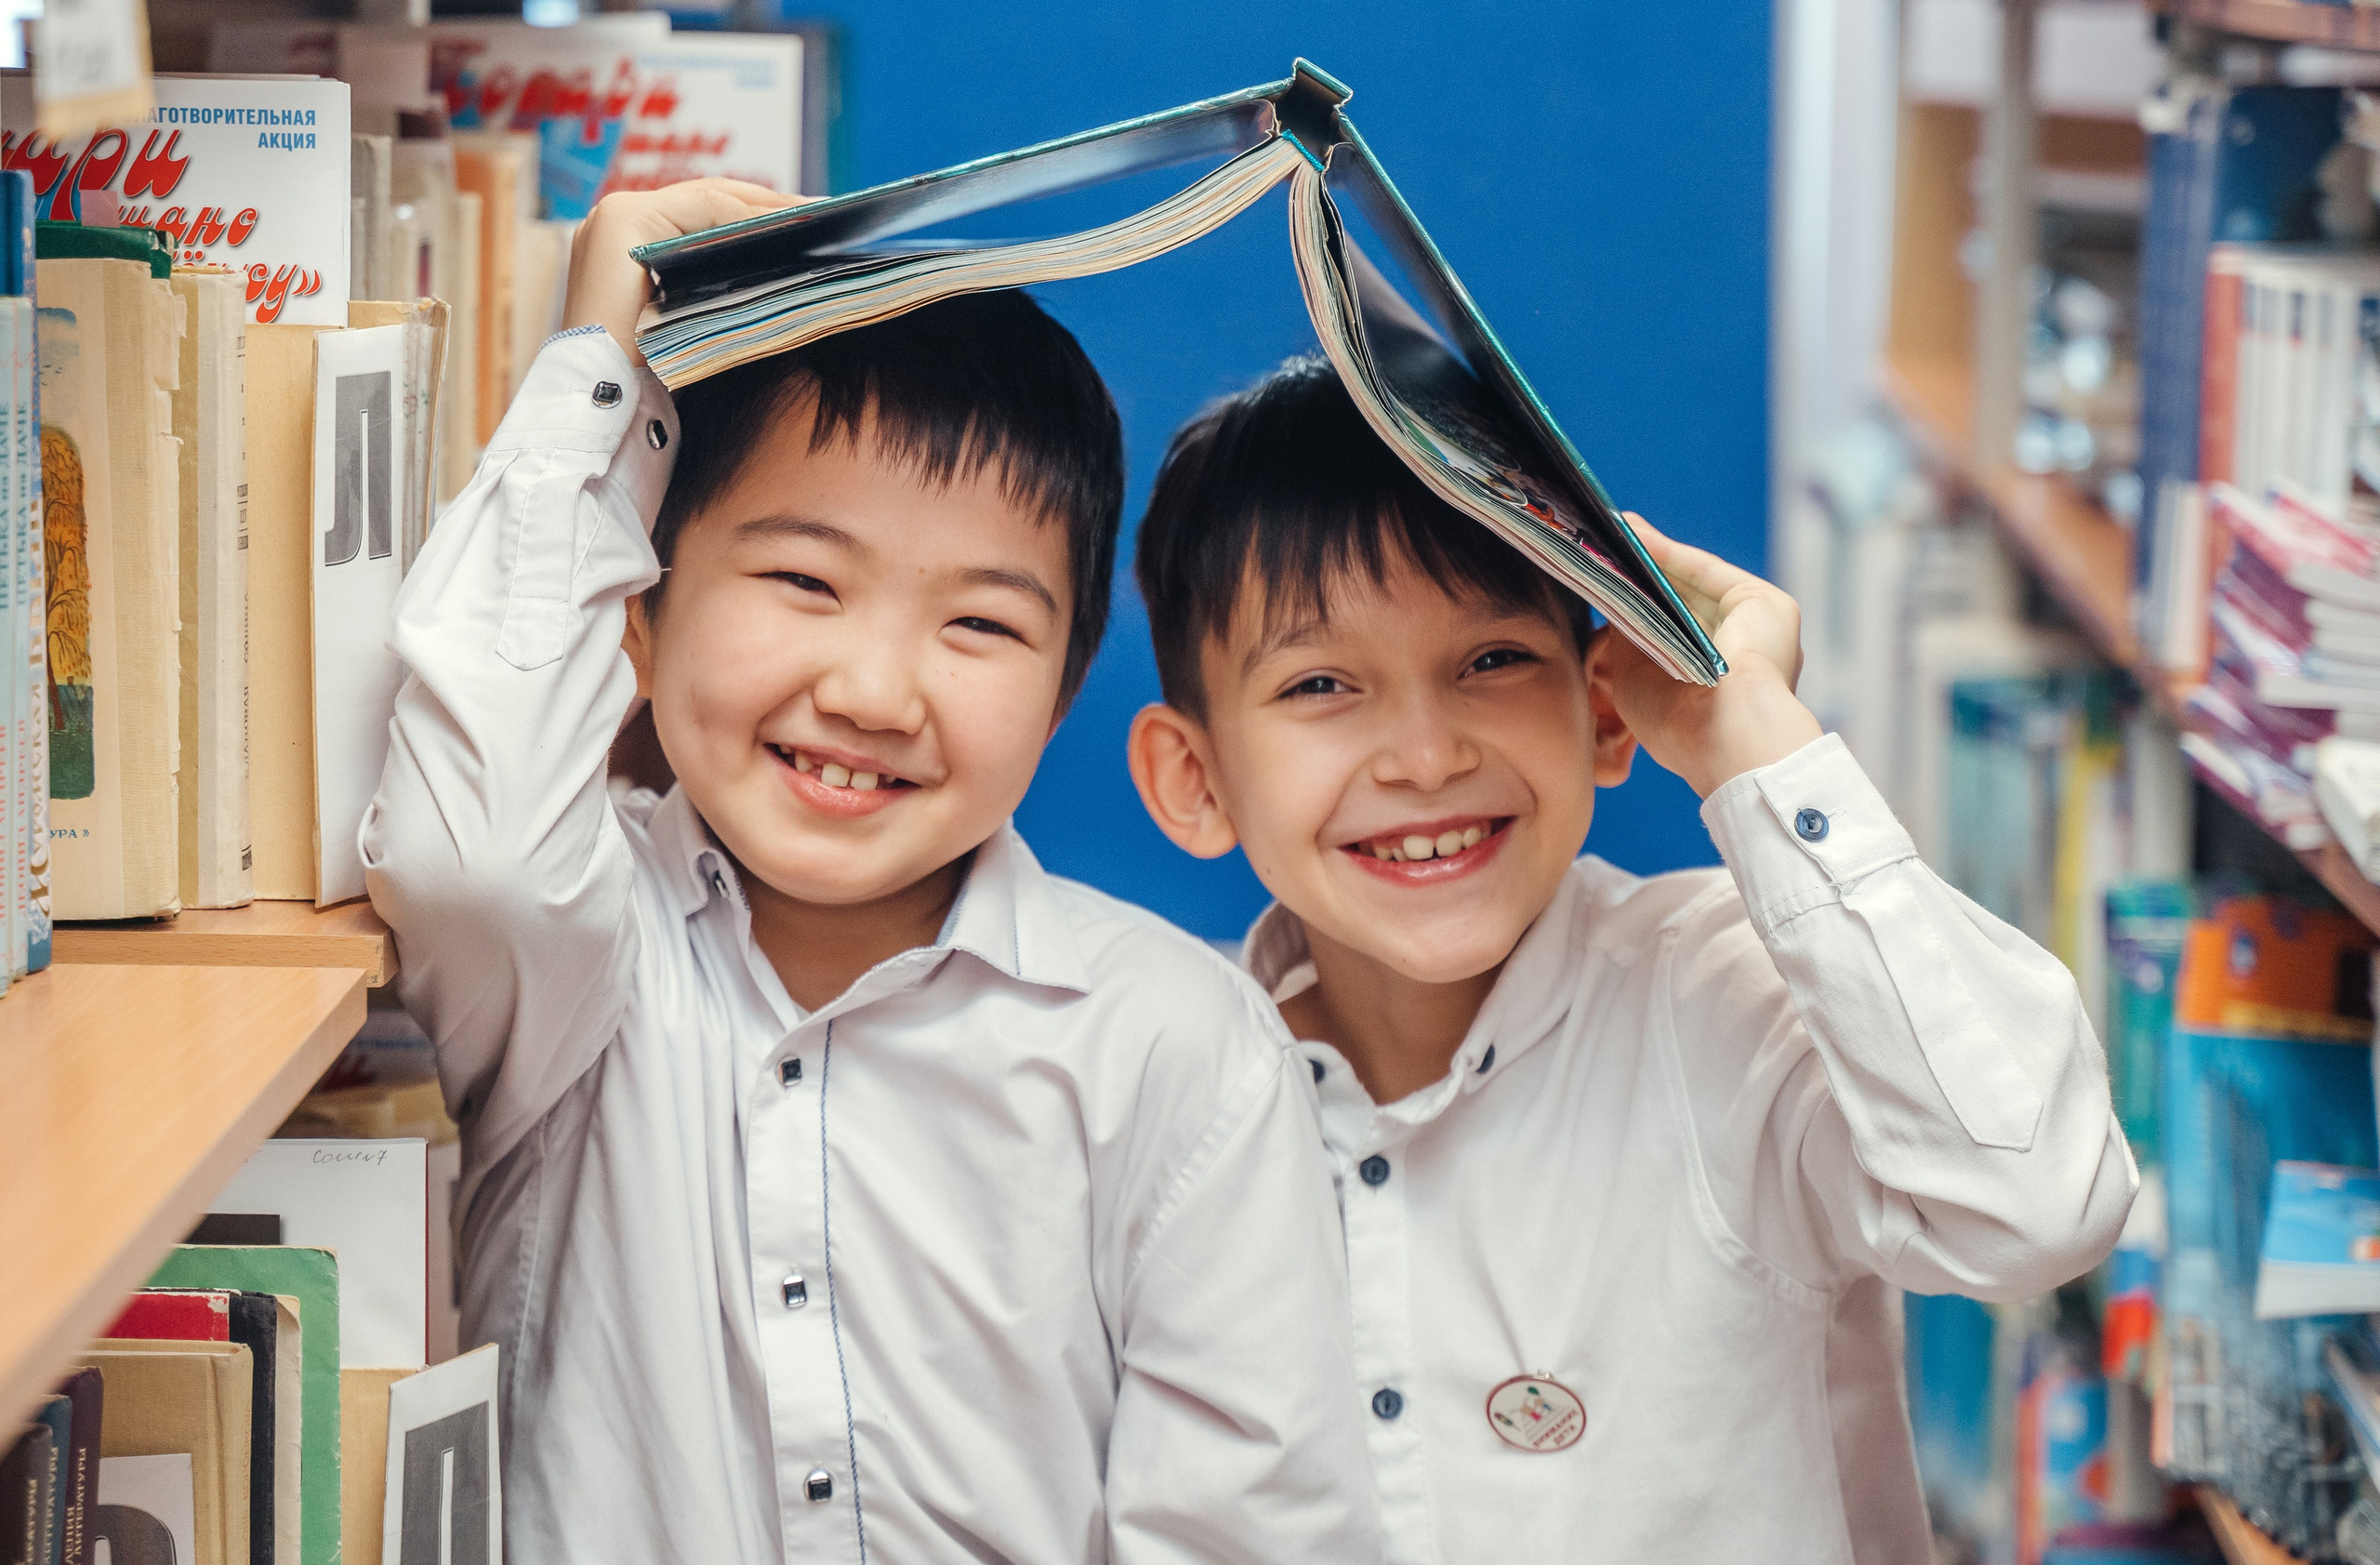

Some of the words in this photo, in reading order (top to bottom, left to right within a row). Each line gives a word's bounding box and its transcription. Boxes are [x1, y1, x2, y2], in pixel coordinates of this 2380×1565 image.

[258, 132, 316, 152] АКЦИЯ
[16, 401, 28, 466] ДАЧЕ
[324, 370, 392, 567] Л
[17, 506, 28, 606] ПЕТЬКА
[74, 1448, 86, 1556] ЛИТЕРАТУРЫ
